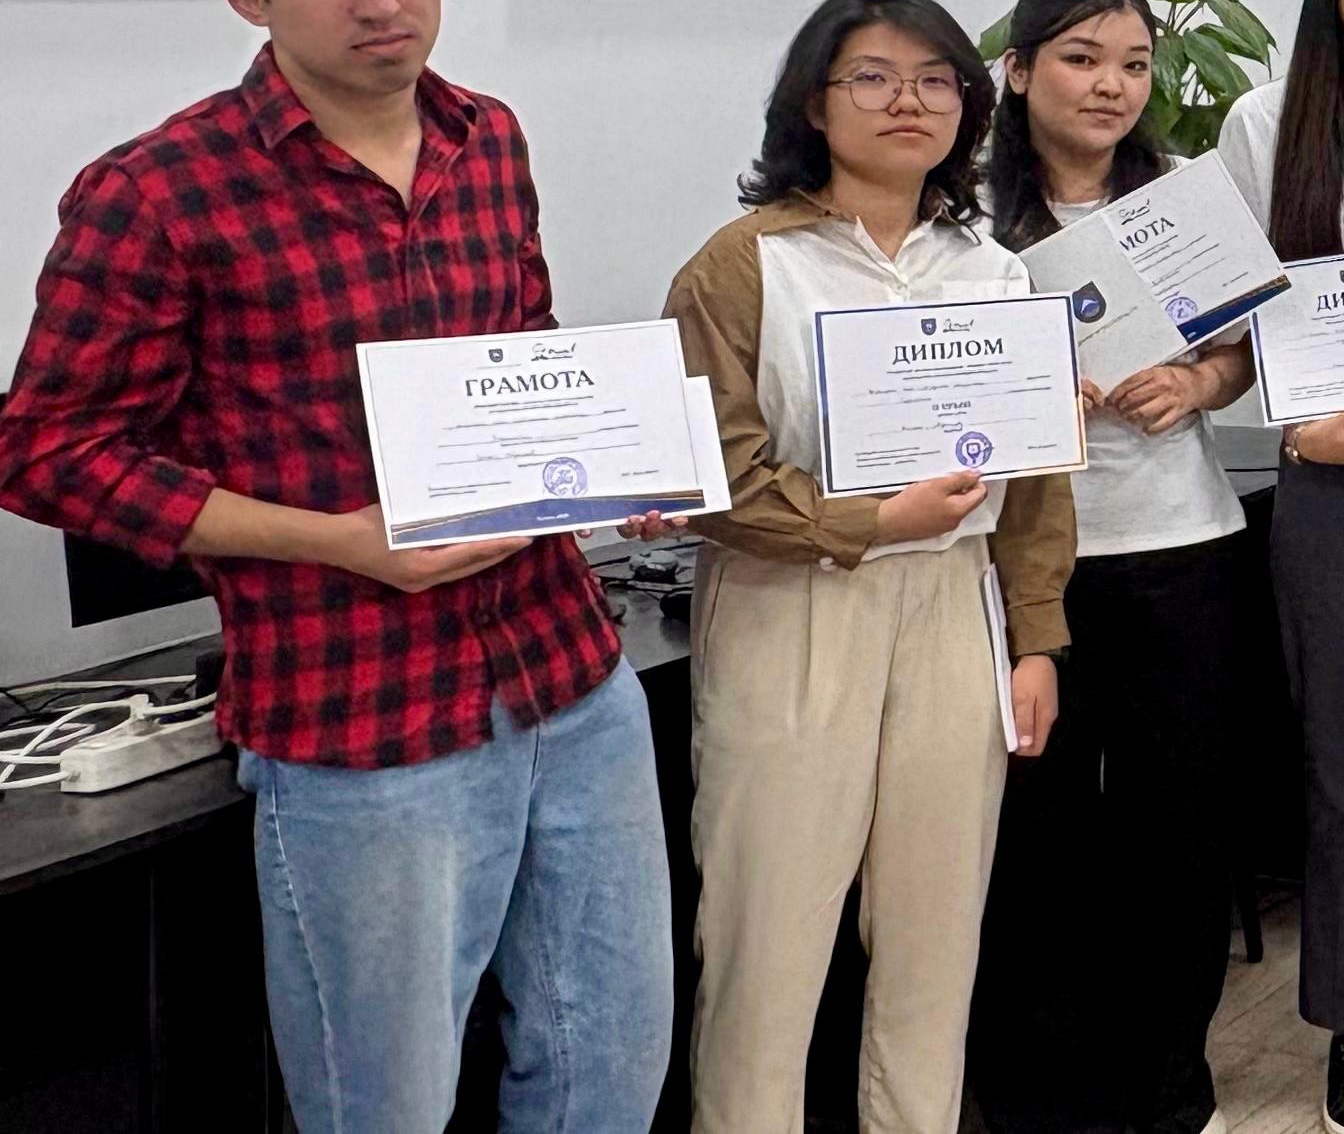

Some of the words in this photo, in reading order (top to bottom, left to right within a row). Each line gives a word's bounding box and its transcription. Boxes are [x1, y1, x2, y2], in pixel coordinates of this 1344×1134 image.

[1119, 216, 1176, 252] МОТА
[892, 337, 1004, 365] ДИПЛОМ
[465, 369, 595, 398] ГРАМОТА
